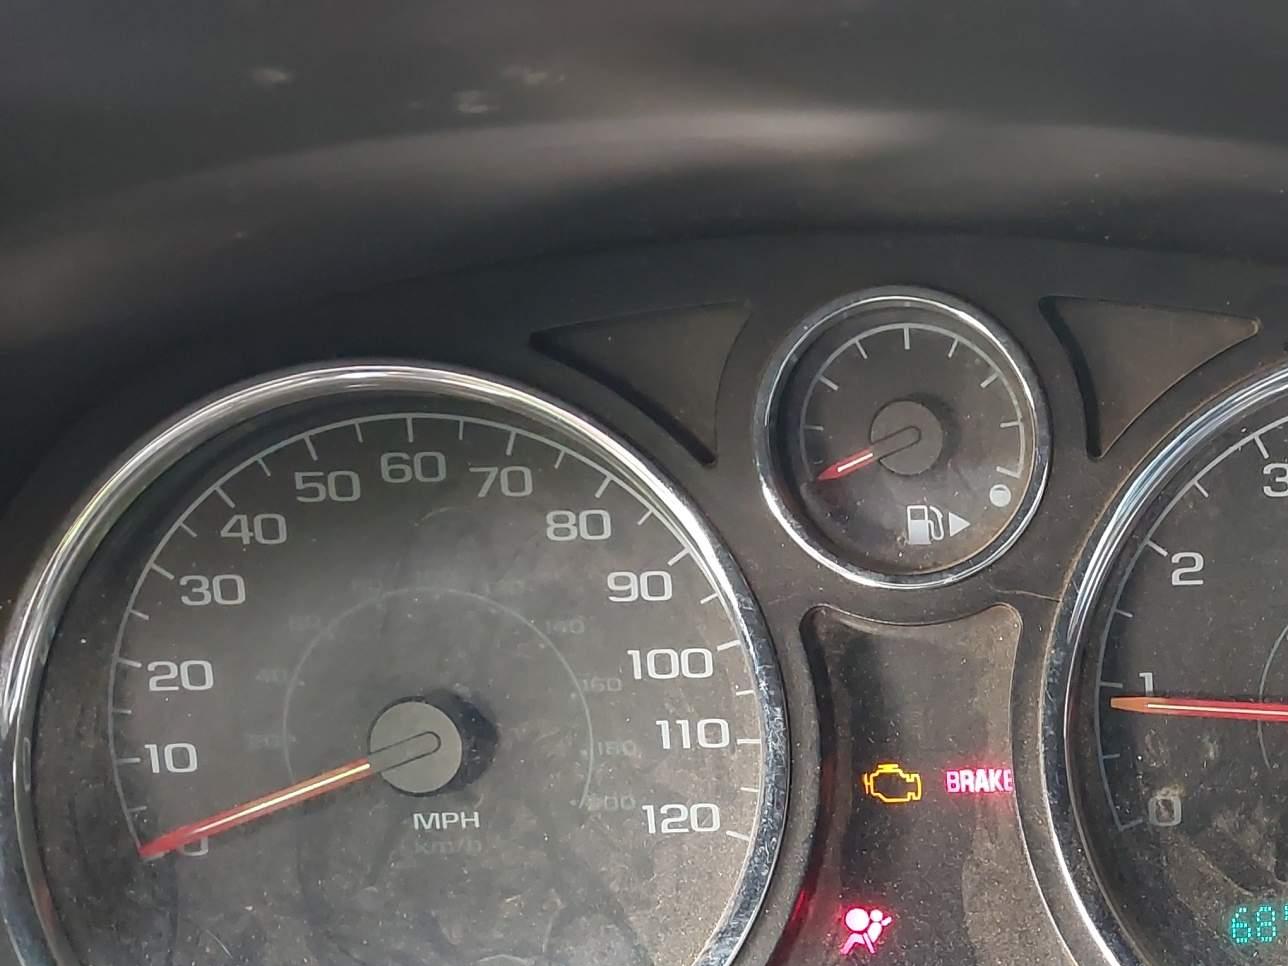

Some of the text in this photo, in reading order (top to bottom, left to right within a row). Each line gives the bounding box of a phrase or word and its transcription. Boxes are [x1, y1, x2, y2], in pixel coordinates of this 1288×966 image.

[380, 451, 446, 482] 60
[469, 466, 533, 497] 70
[294, 471, 361, 502] 50
[220, 513, 287, 545] 40
[546, 510, 612, 541] 80
[1171, 552, 1204, 586] 2
[179, 575, 246, 606] 30
[607, 571, 673, 602] 90
[147, 660, 214, 691] 20
[627, 648, 714, 680] 100
[656, 719, 731, 749] 110
[144, 743, 198, 773] 10
[946, 768, 1014, 793] BRAKE
[413, 811, 480, 830] MPH
[642, 803, 720, 834] 120
[1149, 793, 1182, 826] 0
